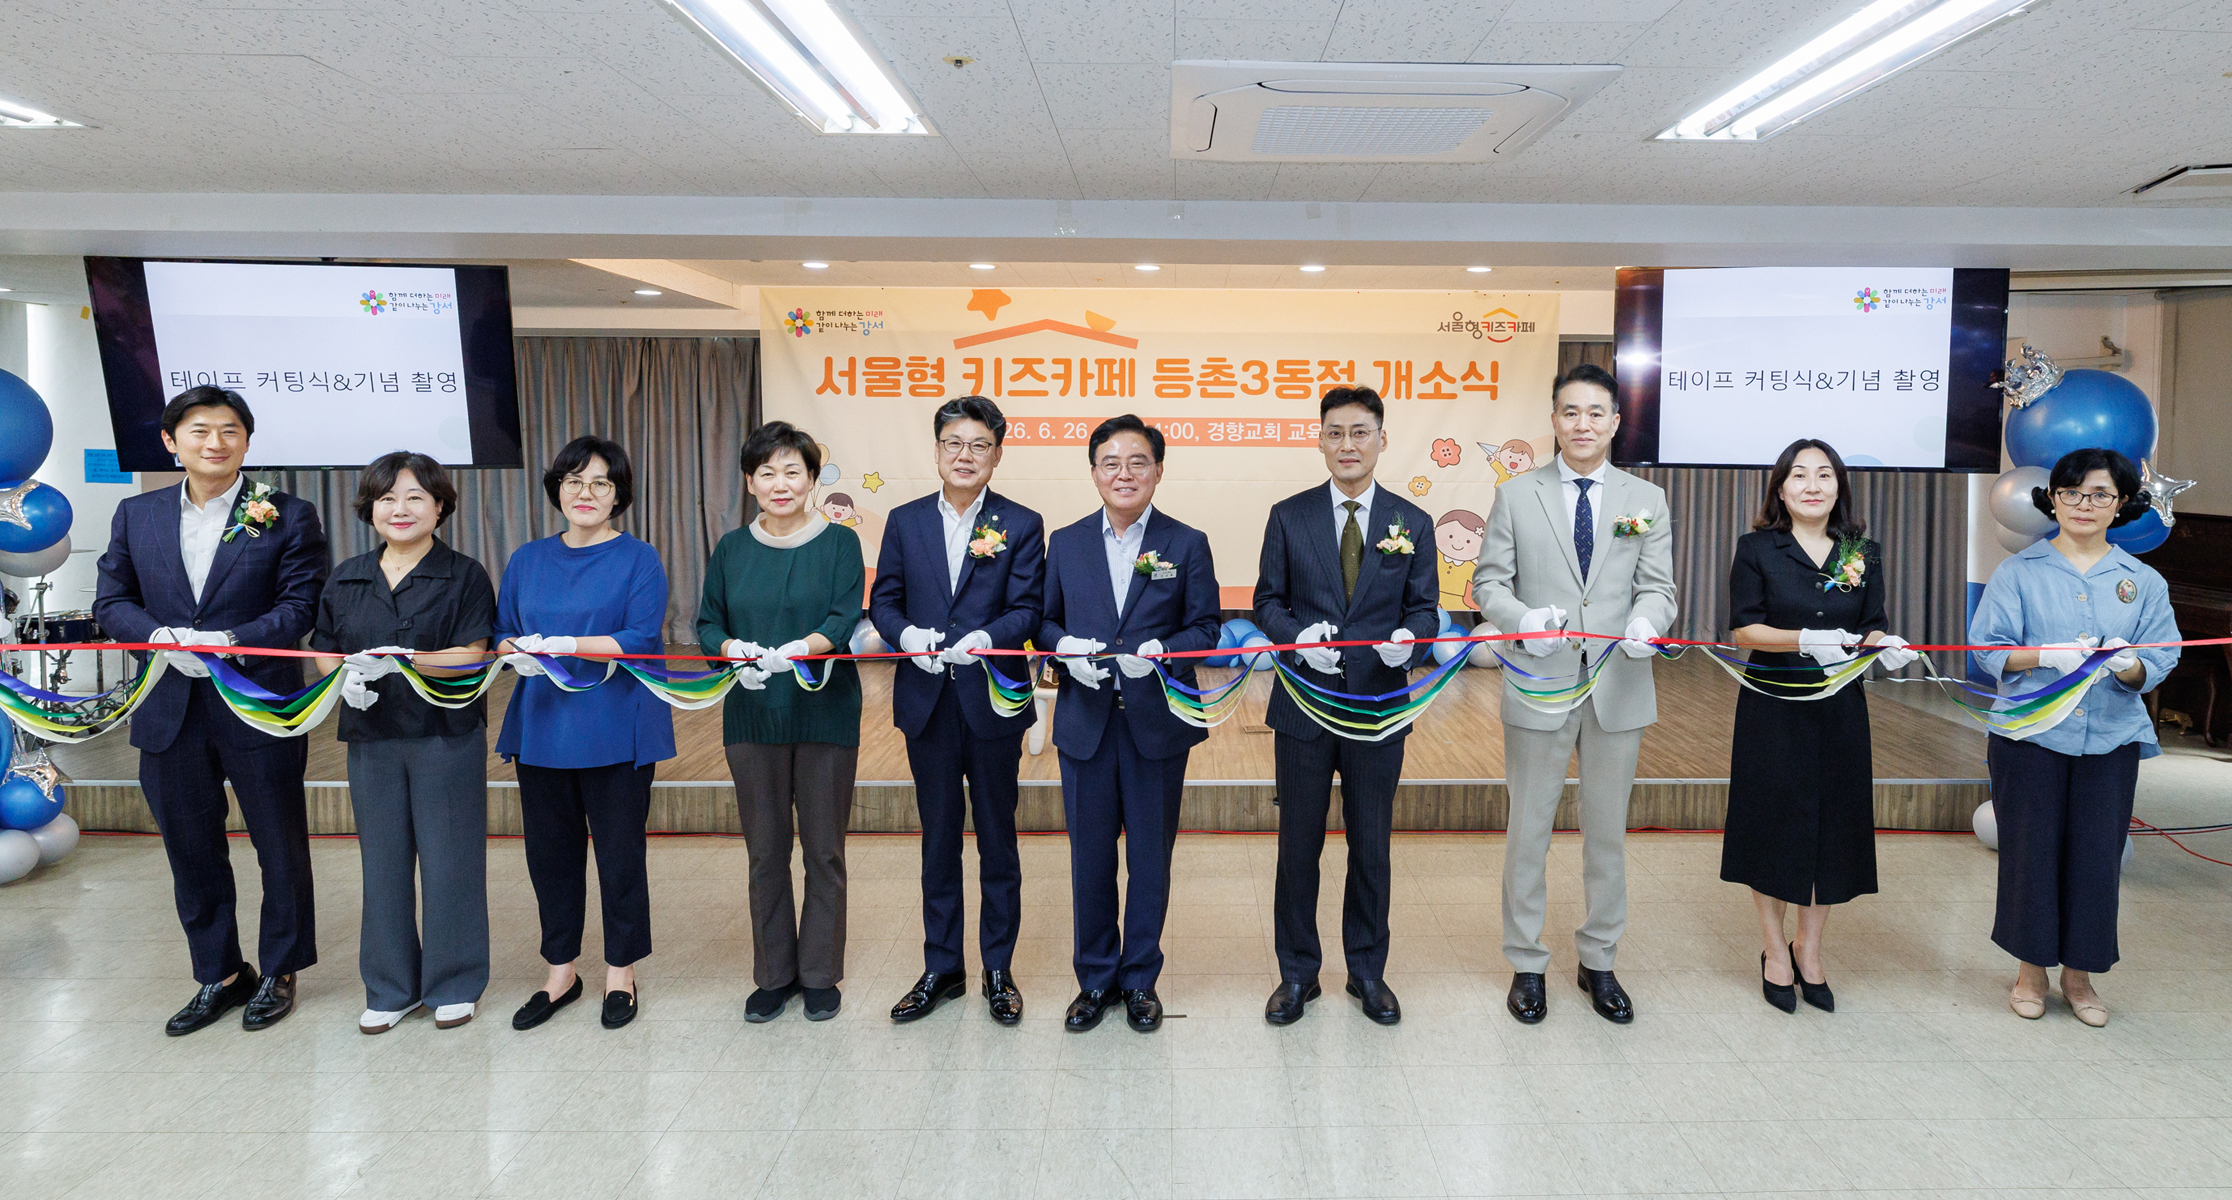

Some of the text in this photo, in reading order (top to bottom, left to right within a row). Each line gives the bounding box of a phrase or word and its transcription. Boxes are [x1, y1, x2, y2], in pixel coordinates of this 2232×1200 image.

[388, 292, 408, 302] 함께
[409, 292, 433, 302] 더하는
[1883, 287, 1947, 298] 함께 더하는 미래
[389, 301, 453, 315] 같이 나누는 강서
[1883, 296, 1947, 311] 같이 나누는 강서
[816, 310, 883, 321] 함께 더하는 미래
[816, 320, 884, 336] 같이 나누는 강서
[1437, 311, 1536, 340] 서울형키즈카페
[170, 370, 457, 393] 테이프 커팅식&기념 촬영
[815, 355, 1500, 401] 서울형 키즈카페 등촌3동점 개소식
[1669, 369, 1940, 391] 테이프 커팅식&기념 촬영
[1038, 422, 1056, 439] 6.
[1207, 422, 1281, 442] 경향교회
